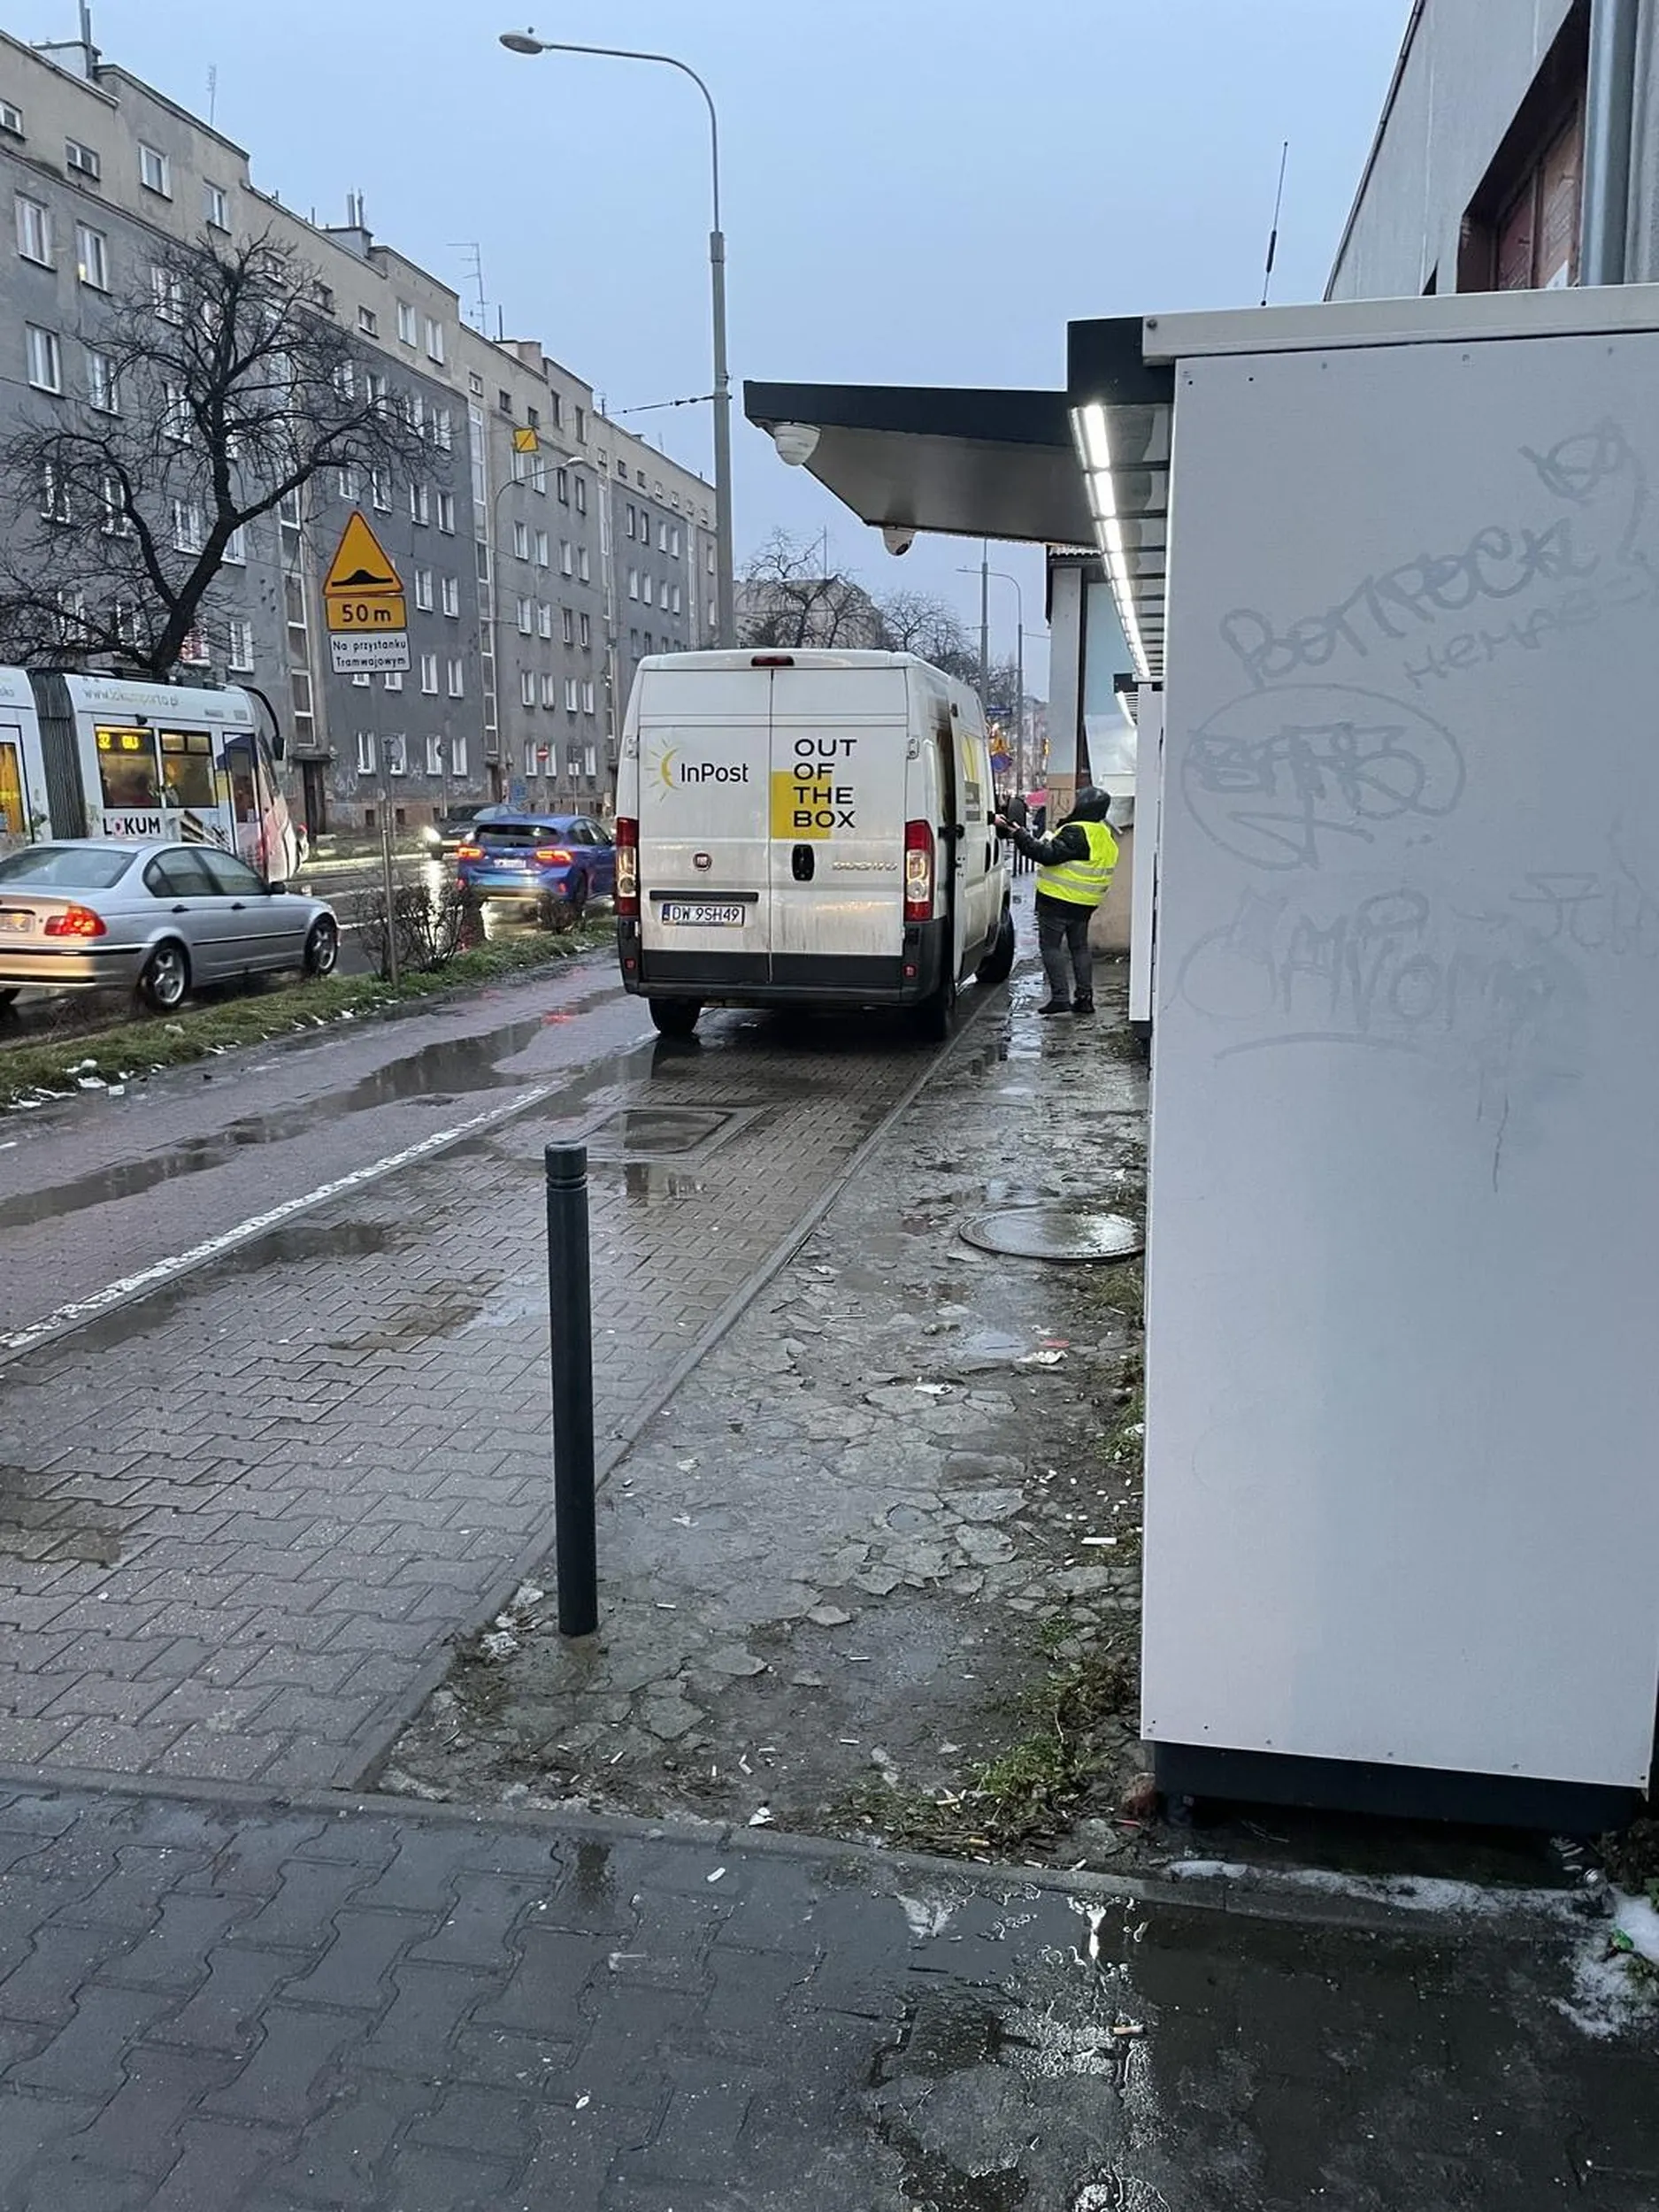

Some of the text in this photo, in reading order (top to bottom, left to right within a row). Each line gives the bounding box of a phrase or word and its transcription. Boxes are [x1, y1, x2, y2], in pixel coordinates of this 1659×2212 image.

[342, 604, 391, 622] 50 m
[333, 639, 406, 652] Na przystanku
[336, 655, 406, 668] Tramwajowym
[794, 738, 857, 757] OUT
[680, 763, 749, 782] InPost
[793, 763, 835, 780] OF
[793, 787, 854, 804] THE
[793, 810, 856, 828] BOX
[672, 906, 741, 922] DW 9SH49
